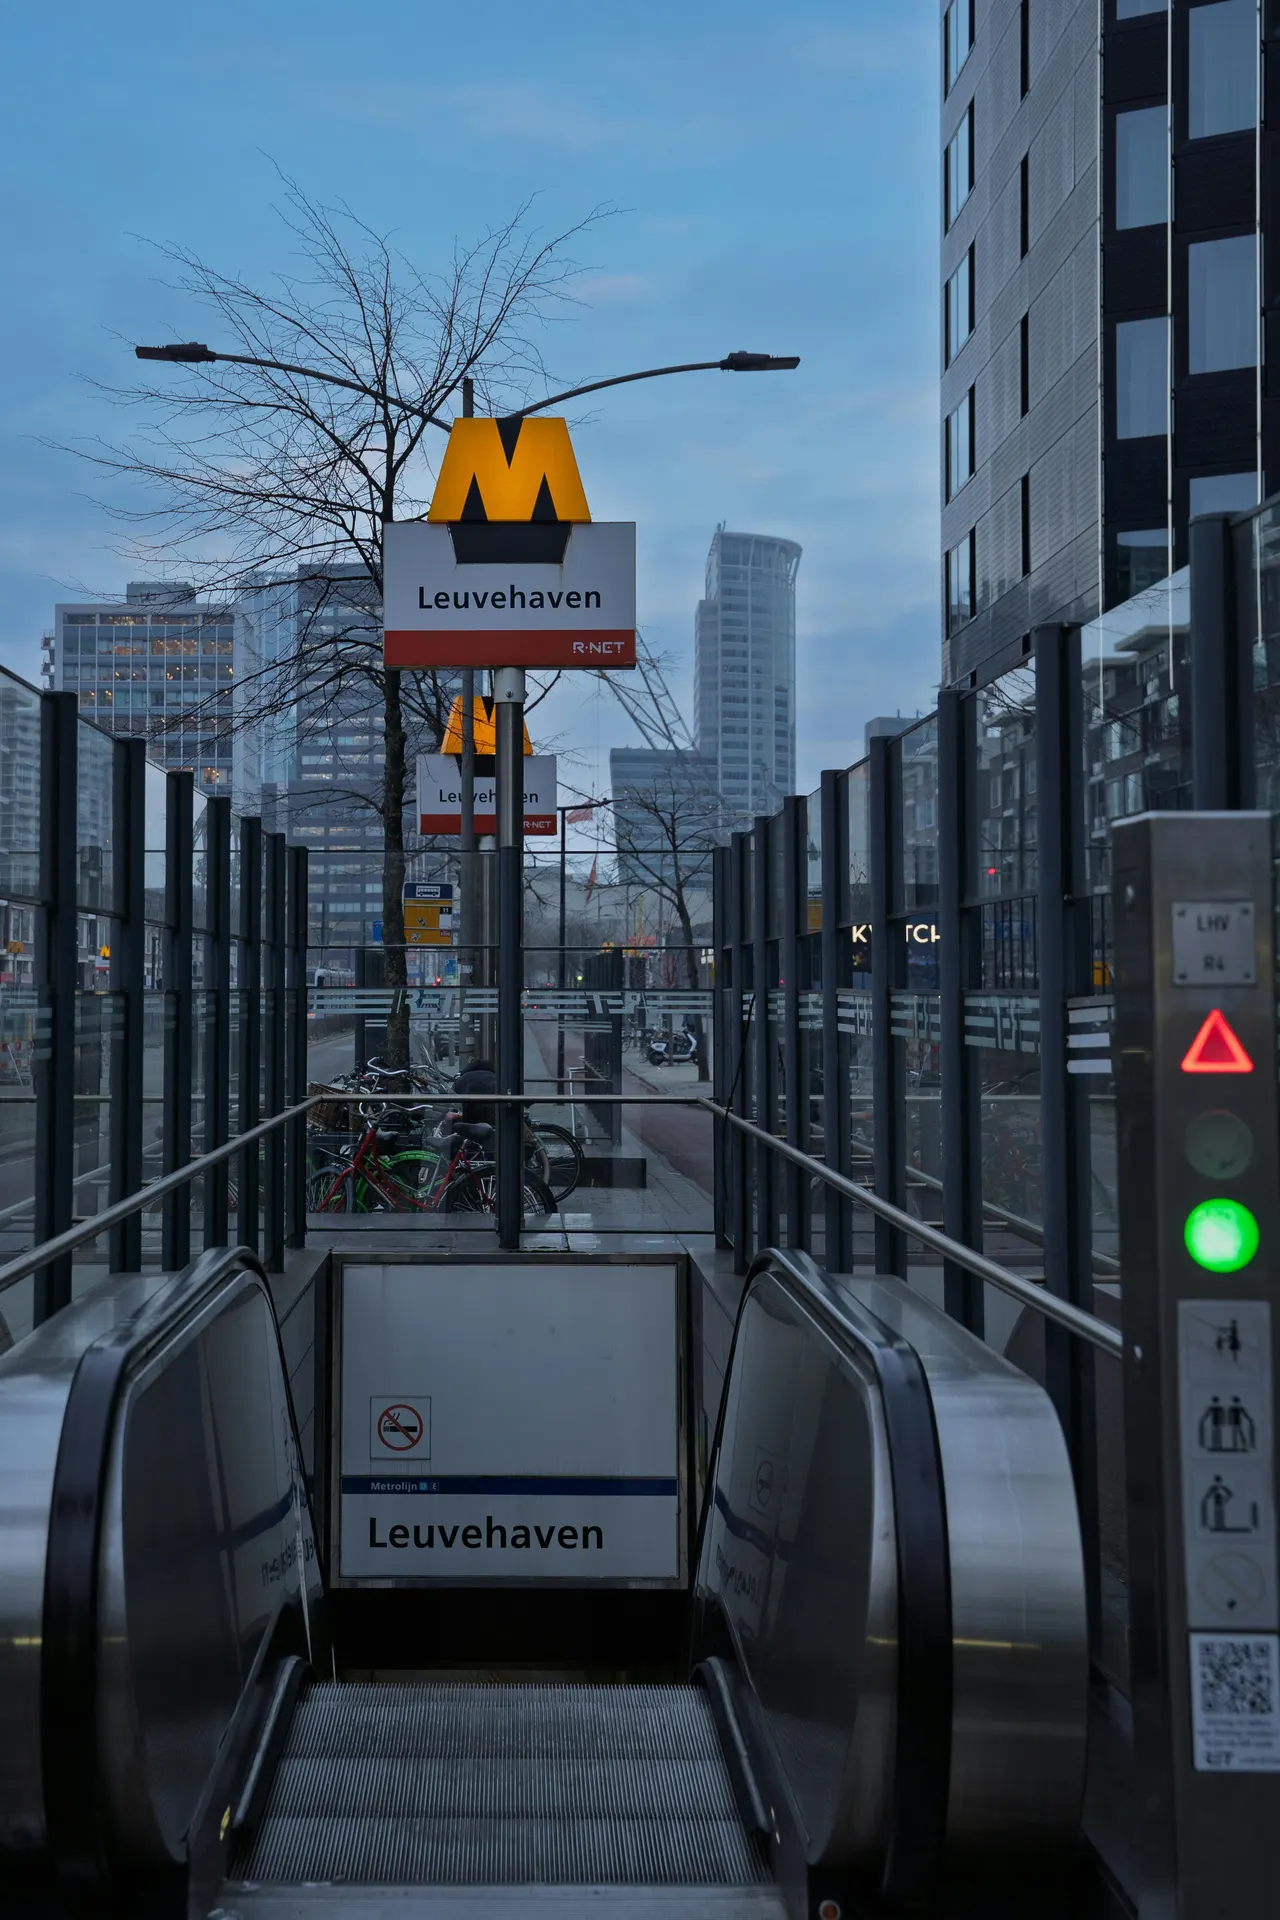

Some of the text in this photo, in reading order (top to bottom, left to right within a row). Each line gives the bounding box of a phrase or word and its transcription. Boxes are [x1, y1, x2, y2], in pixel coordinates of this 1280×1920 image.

[419, 585, 601, 609] Leuvehaven
[1196, 914, 1230, 932] LHV
[1202, 954, 1225, 973] R4
[371, 1481, 418, 1492] Metrolijn
[369, 1516, 603, 1549] Leuvehaven
